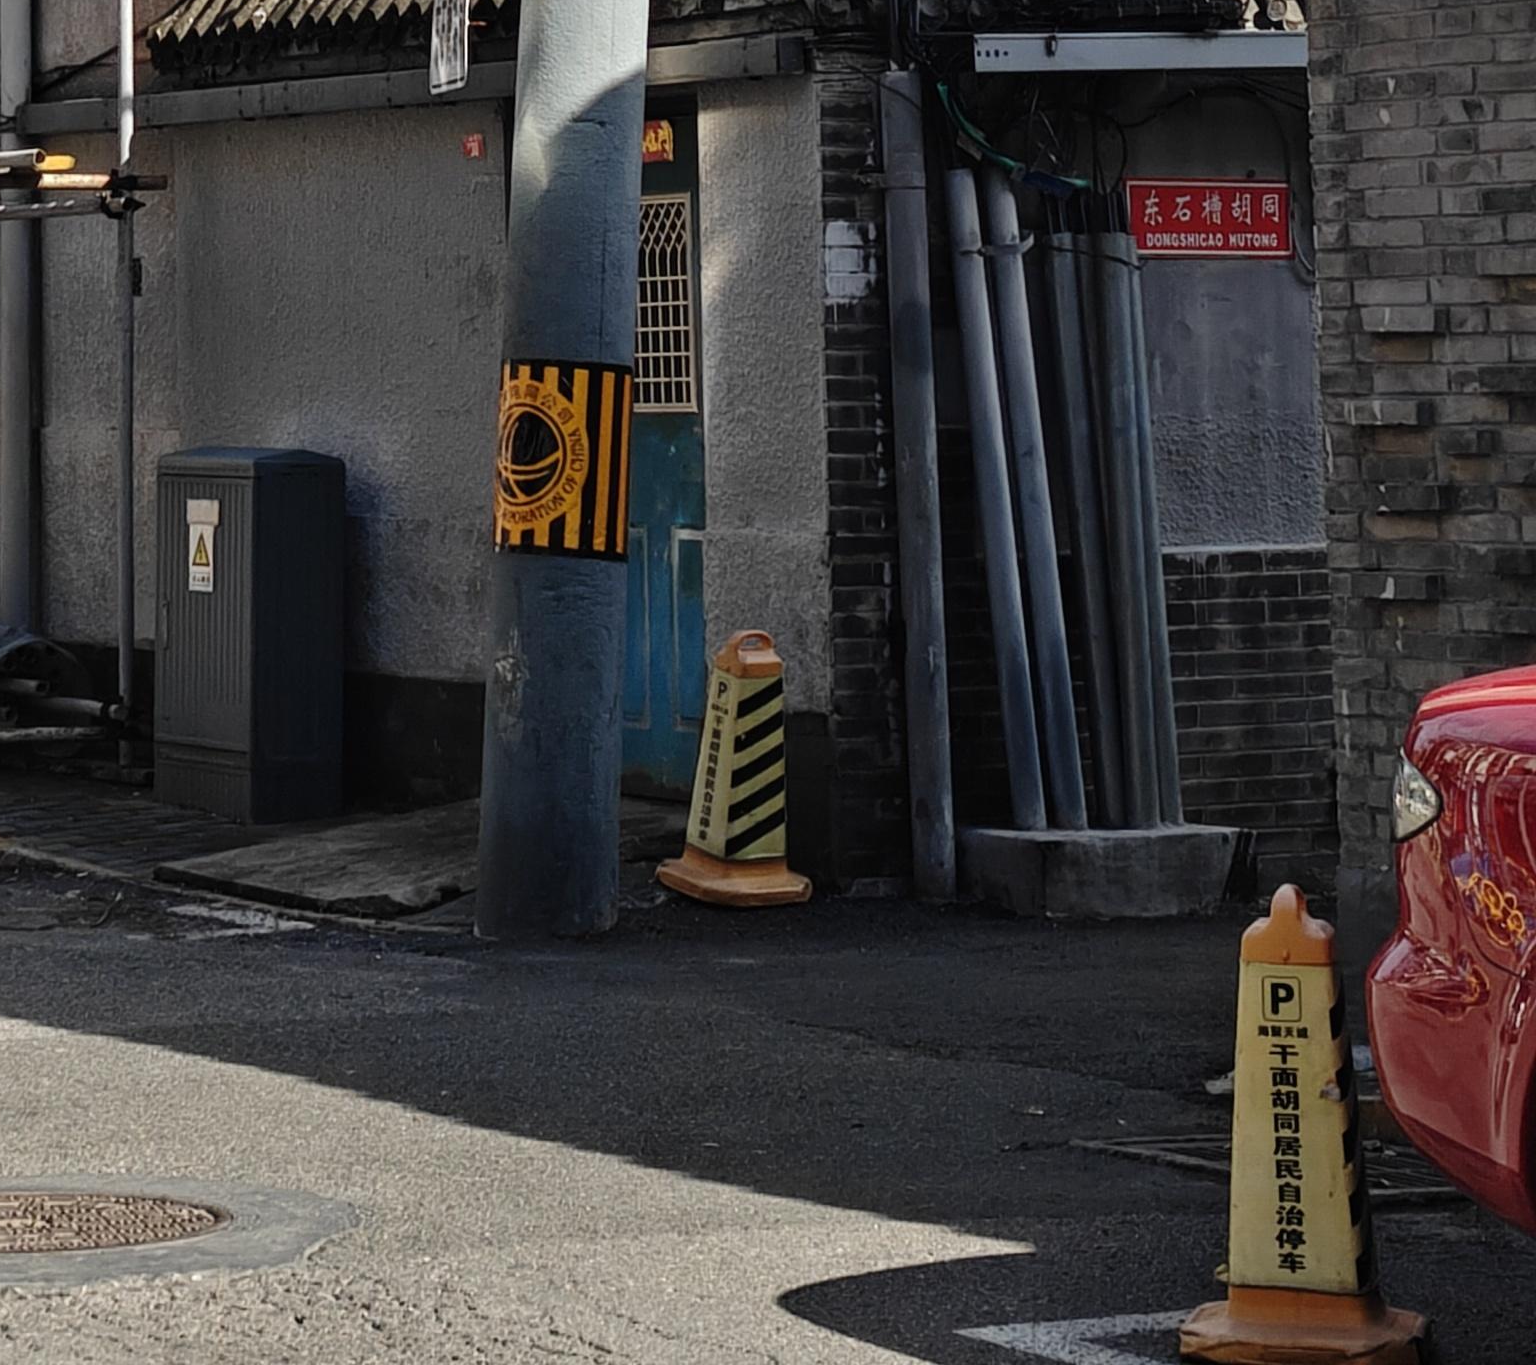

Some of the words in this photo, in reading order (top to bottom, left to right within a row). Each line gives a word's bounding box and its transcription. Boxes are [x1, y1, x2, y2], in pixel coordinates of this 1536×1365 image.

[1143, 189, 1280, 226] 东石槽胡同
[1146, 233, 1223, 247] DONGSHICAO
[1229, 233, 1278, 247] HUTONG
[568, 427, 584, 472] CHINA
[564, 475, 578, 494] OF
[718, 681, 728, 699] P
[1271, 983, 1294, 1015] P
